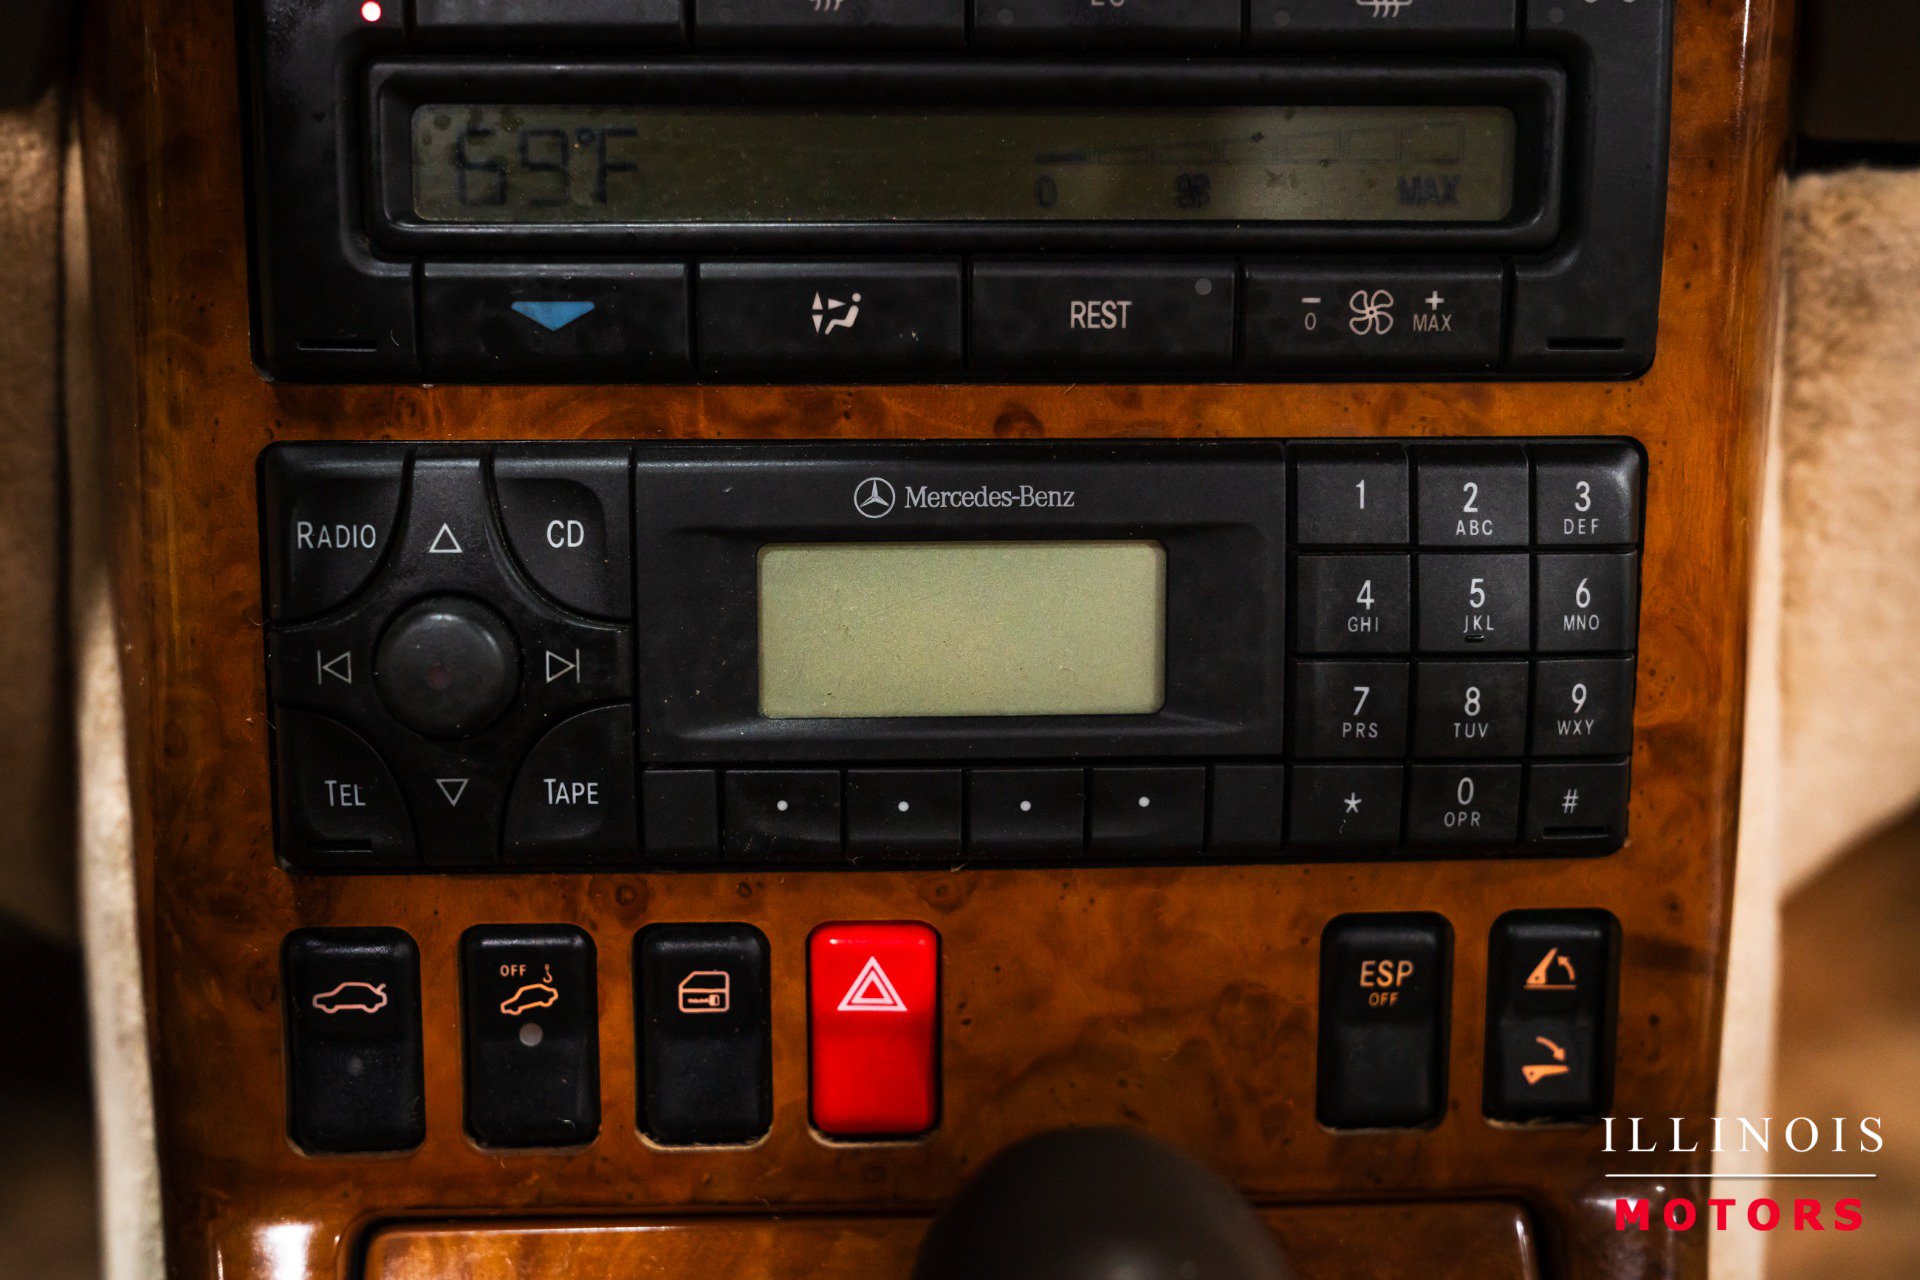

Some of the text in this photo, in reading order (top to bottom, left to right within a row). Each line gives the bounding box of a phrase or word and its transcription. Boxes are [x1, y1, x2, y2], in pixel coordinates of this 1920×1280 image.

[1396, 174, 1461, 206] MAX
[1070, 300, 1132, 330] REST
[1412, 313, 1452, 332] MAX
[904, 485, 1075, 509] Mercedes-Benz
[1355, 479, 1366, 510] 1
[1462, 481, 1479, 513] 2
[1574, 480, 1591, 512] 3
[297, 521, 377, 549] RADIO
[546, 519, 585, 549] CD
[1455, 520, 1493, 536] ABC
[1563, 518, 1599, 535] DEF
[1356, 579, 1375, 610] 4
[1469, 578, 1486, 609] 5
[1575, 577, 1591, 609] 6
[1347, 616, 1379, 633] GHI
[1463, 614, 1495, 632] JKL
[1563, 614, 1600, 631] MNO
[1353, 686, 1370, 716] 7
[1464, 686, 1481, 717] 8
[1571, 683, 1587, 714] 9
[1342, 722, 1378, 739] PRS
[1453, 722, 1489, 739] TUV
[1557, 719, 1595, 736] WXY
[324, 779, 366, 807] TEL
[543, 778, 599, 805] TAPE
[1457, 776, 1475, 806] 0
[1443, 811, 1481, 828] OPR
[499, 964, 527, 977] OFF
[1360, 959, 1414, 988] ESP
[1368, 991, 1398, 1007] OFF
